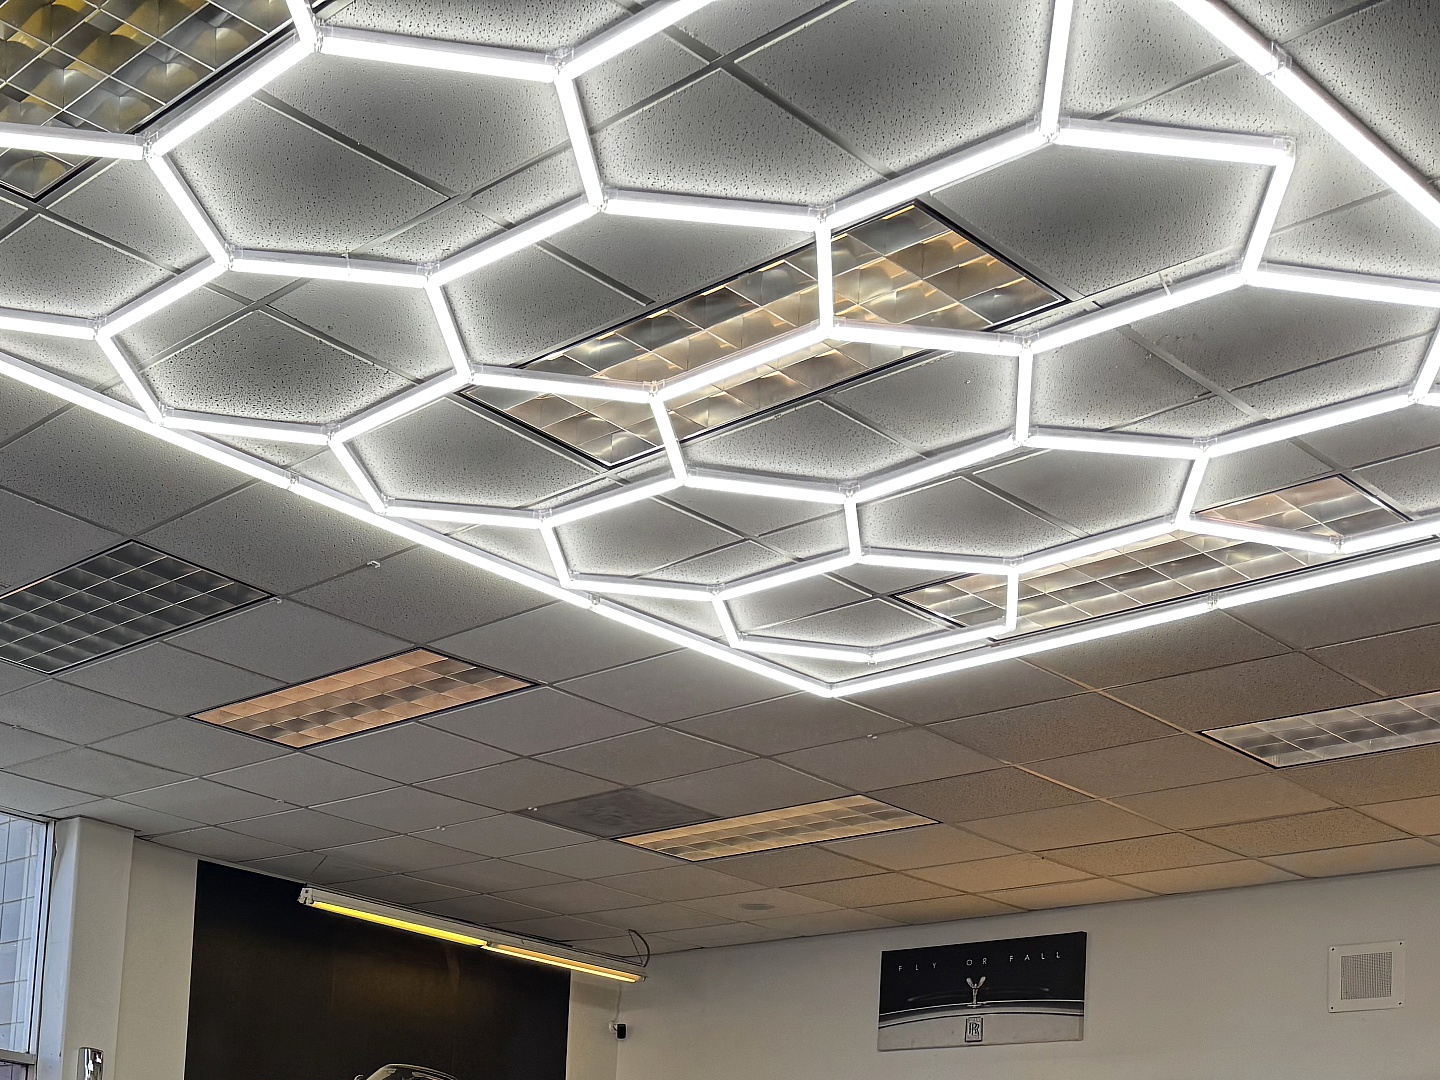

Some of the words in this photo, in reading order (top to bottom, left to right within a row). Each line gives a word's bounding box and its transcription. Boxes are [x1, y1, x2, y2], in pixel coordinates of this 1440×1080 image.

[898, 962, 937, 972] FLY
[966, 957, 988, 966] OR
[1009, 951, 1061, 962] FALL
